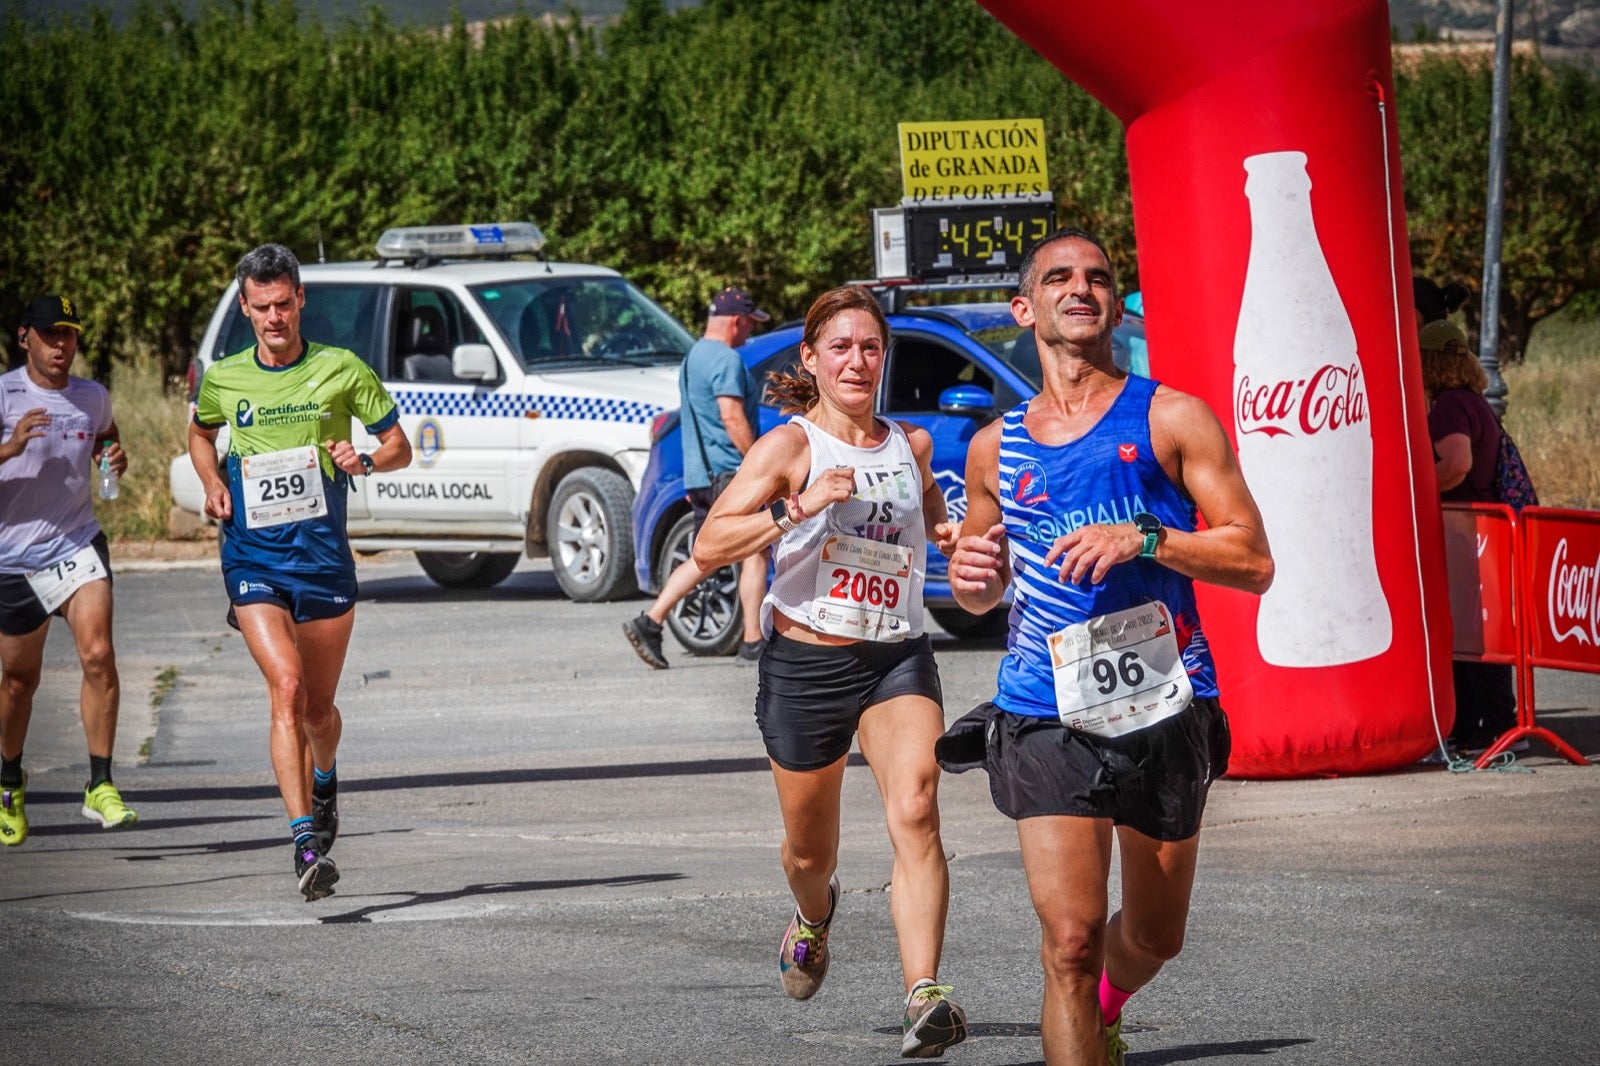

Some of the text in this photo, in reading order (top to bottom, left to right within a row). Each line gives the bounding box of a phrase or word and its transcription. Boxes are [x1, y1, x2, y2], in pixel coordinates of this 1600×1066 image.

[906, 122, 1038, 151] DIPUTACIÓN
[909, 155, 1040, 178] de GRANADA
[913, 182, 1043, 202] DEPORTES
[258, 401, 319, 416] Certificado
[1236, 363, 1366, 438] Coca-Cola
[258, 413, 320, 426] electronico
[259, 474, 305, 502] 259
[377, 482, 493, 499] POLICIA LOCAL
[867, 501, 894, 523] IS
[829, 568, 900, 609] 2069
[1092, 651, 1145, 695] 96
